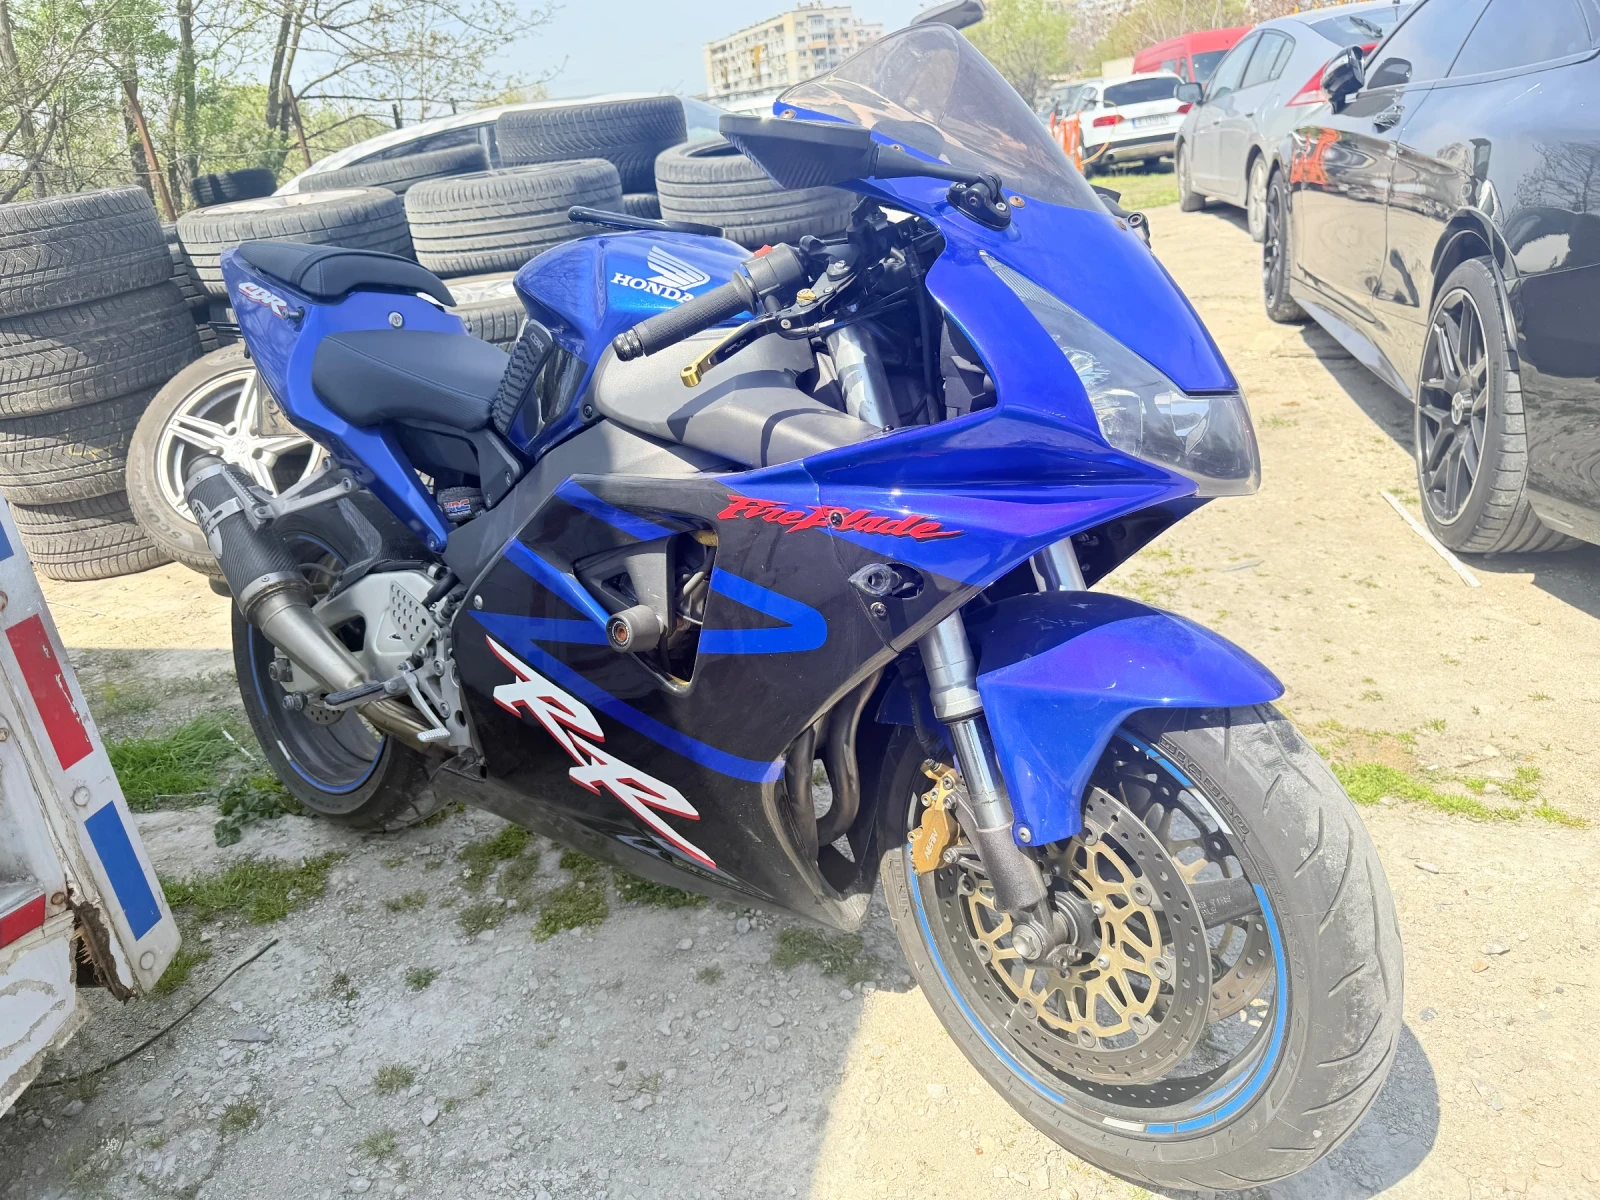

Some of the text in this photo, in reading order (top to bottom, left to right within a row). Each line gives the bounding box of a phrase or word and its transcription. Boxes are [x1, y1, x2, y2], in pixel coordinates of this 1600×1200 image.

[238, 281, 287, 320] CBR
[611, 272, 695, 303] HONDA
[530, 332, 545, 353] CBR
[716, 494, 965, 539] FireBlade
[486, 634, 717, 870] RR
